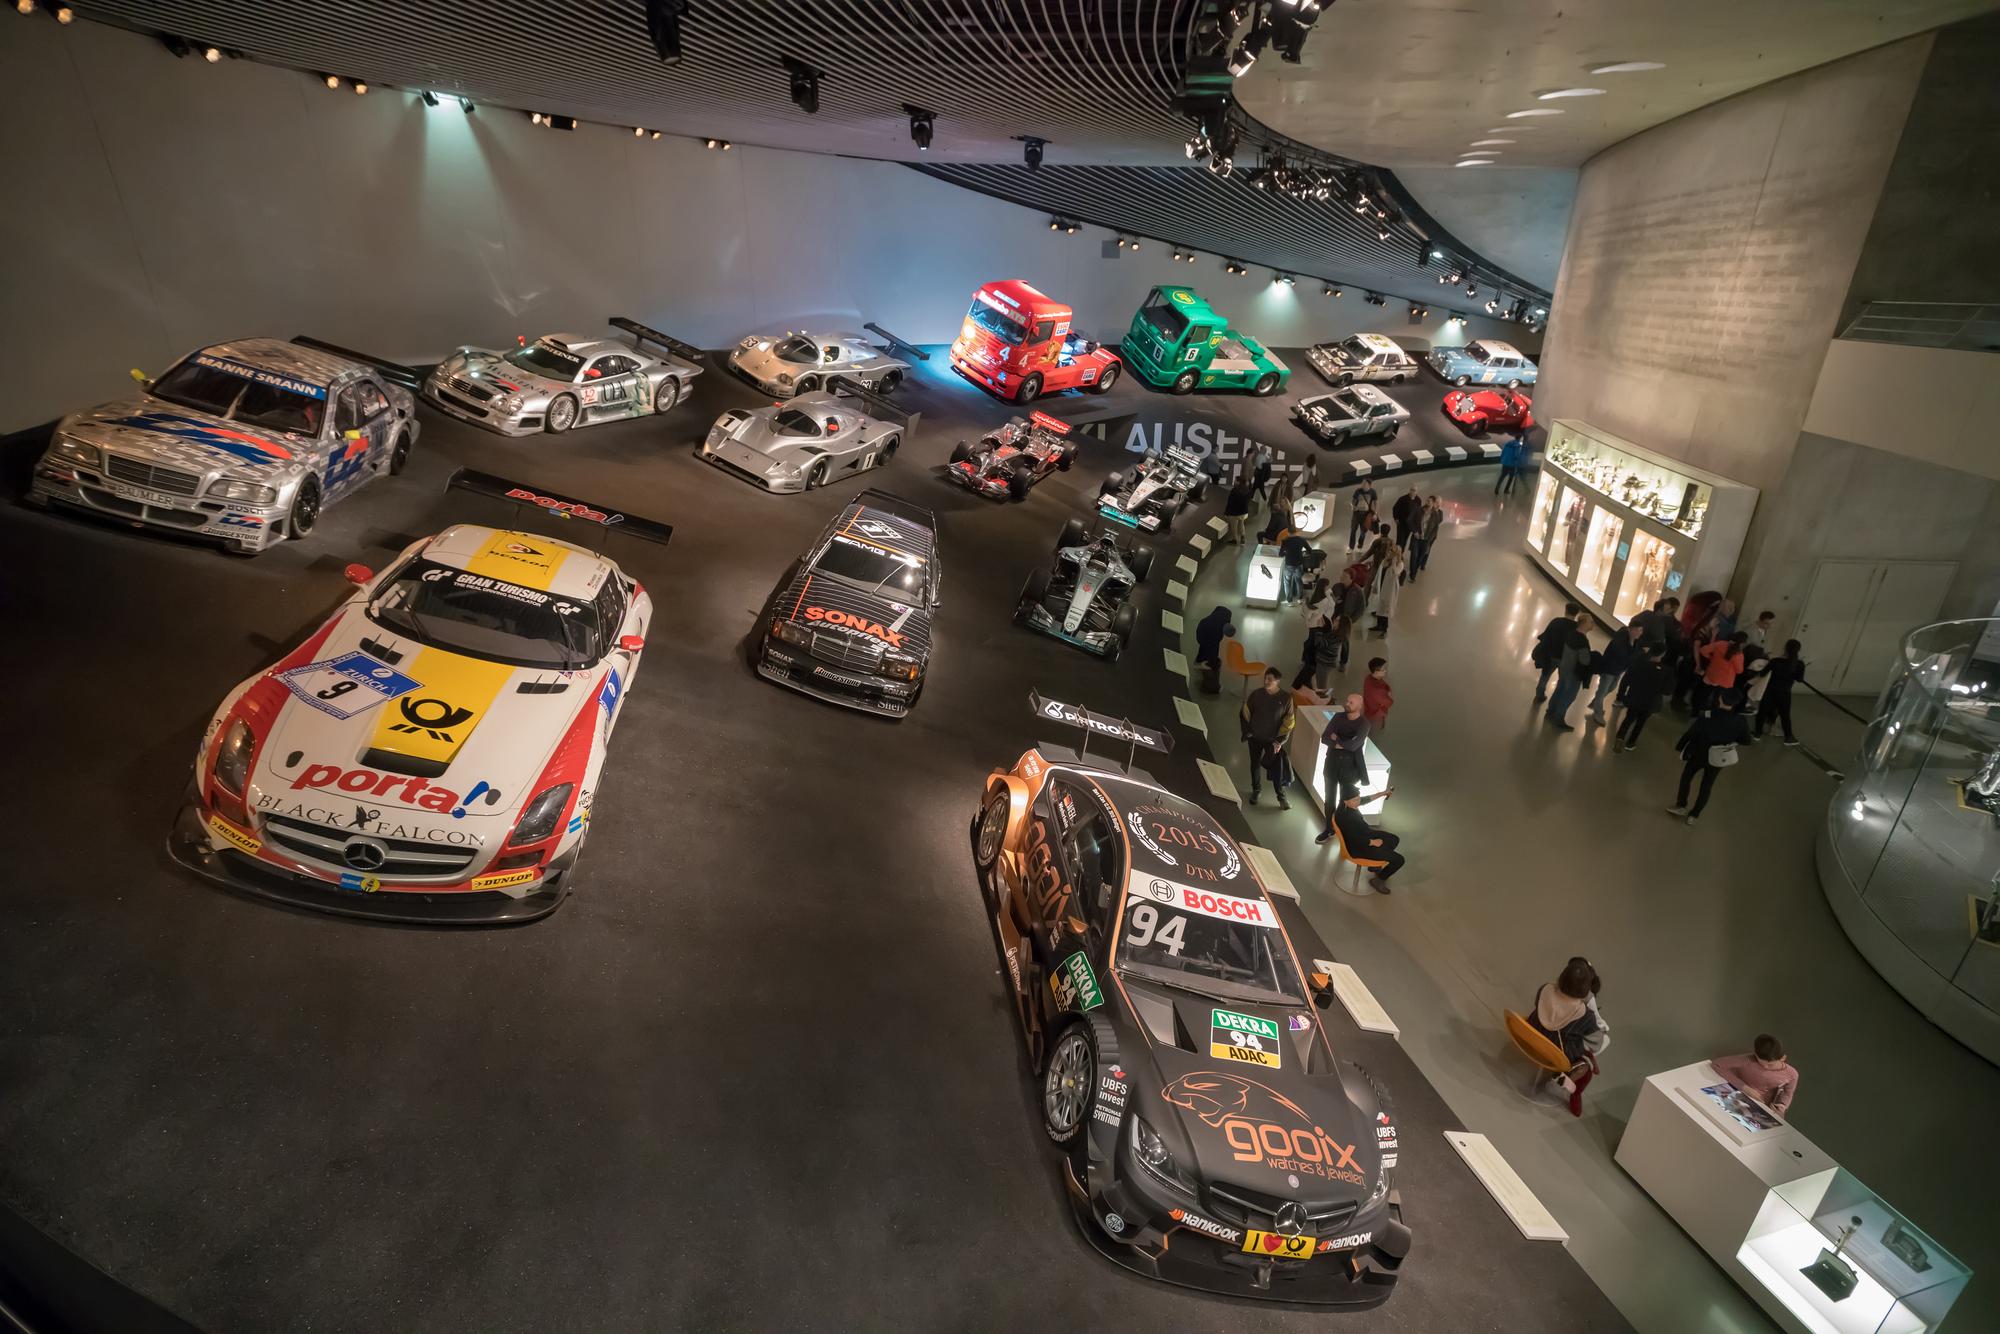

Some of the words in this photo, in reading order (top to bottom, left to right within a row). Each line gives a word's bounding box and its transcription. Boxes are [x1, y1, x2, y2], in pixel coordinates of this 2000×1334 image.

[1000, 346, 1010, 360] 4
[1019, 354, 1028, 366] 4
[1188, 349, 1195, 359] 6
[722, 417, 734, 428] 1
[456, 573, 494, 589] GRAN
[494, 581, 548, 604] TURISMO
[804, 607, 904, 648] SONAX
[317, 681, 359, 700] 9
[343, 668, 389, 693] ZURICH
[256, 795, 343, 826] BLACK
[374, 821, 485, 847] FALCON
[216, 823, 259, 850] DUNLOP
[1151, 822, 1218, 855] 2015
[483, 873, 533, 886] DUNLOP
[1185, 863, 1219, 882] DTM
[1183, 889, 1263, 922] BOSCH
[1126, 904, 1188, 957] 94
[1061, 974, 1077, 1005] 94
[1070, 954, 1097, 1007] DEKRA
[1216, 1012, 1276, 1037] DEKRA
[1230, 1030, 1263, 1051] 94
[1229, 1046, 1268, 1065] ADAC
[1102, 1076, 1128, 1095] UBFS
[1098, 1087, 1125, 1107] invest
[1376, 1126, 1397, 1138] UBFS
[1224, 1120, 1366, 1174] gooix
[1377, 1138, 1399, 1149] invest
[1267, 1157, 1315, 1174] watches
[1317, 1162, 1325, 1177] &
